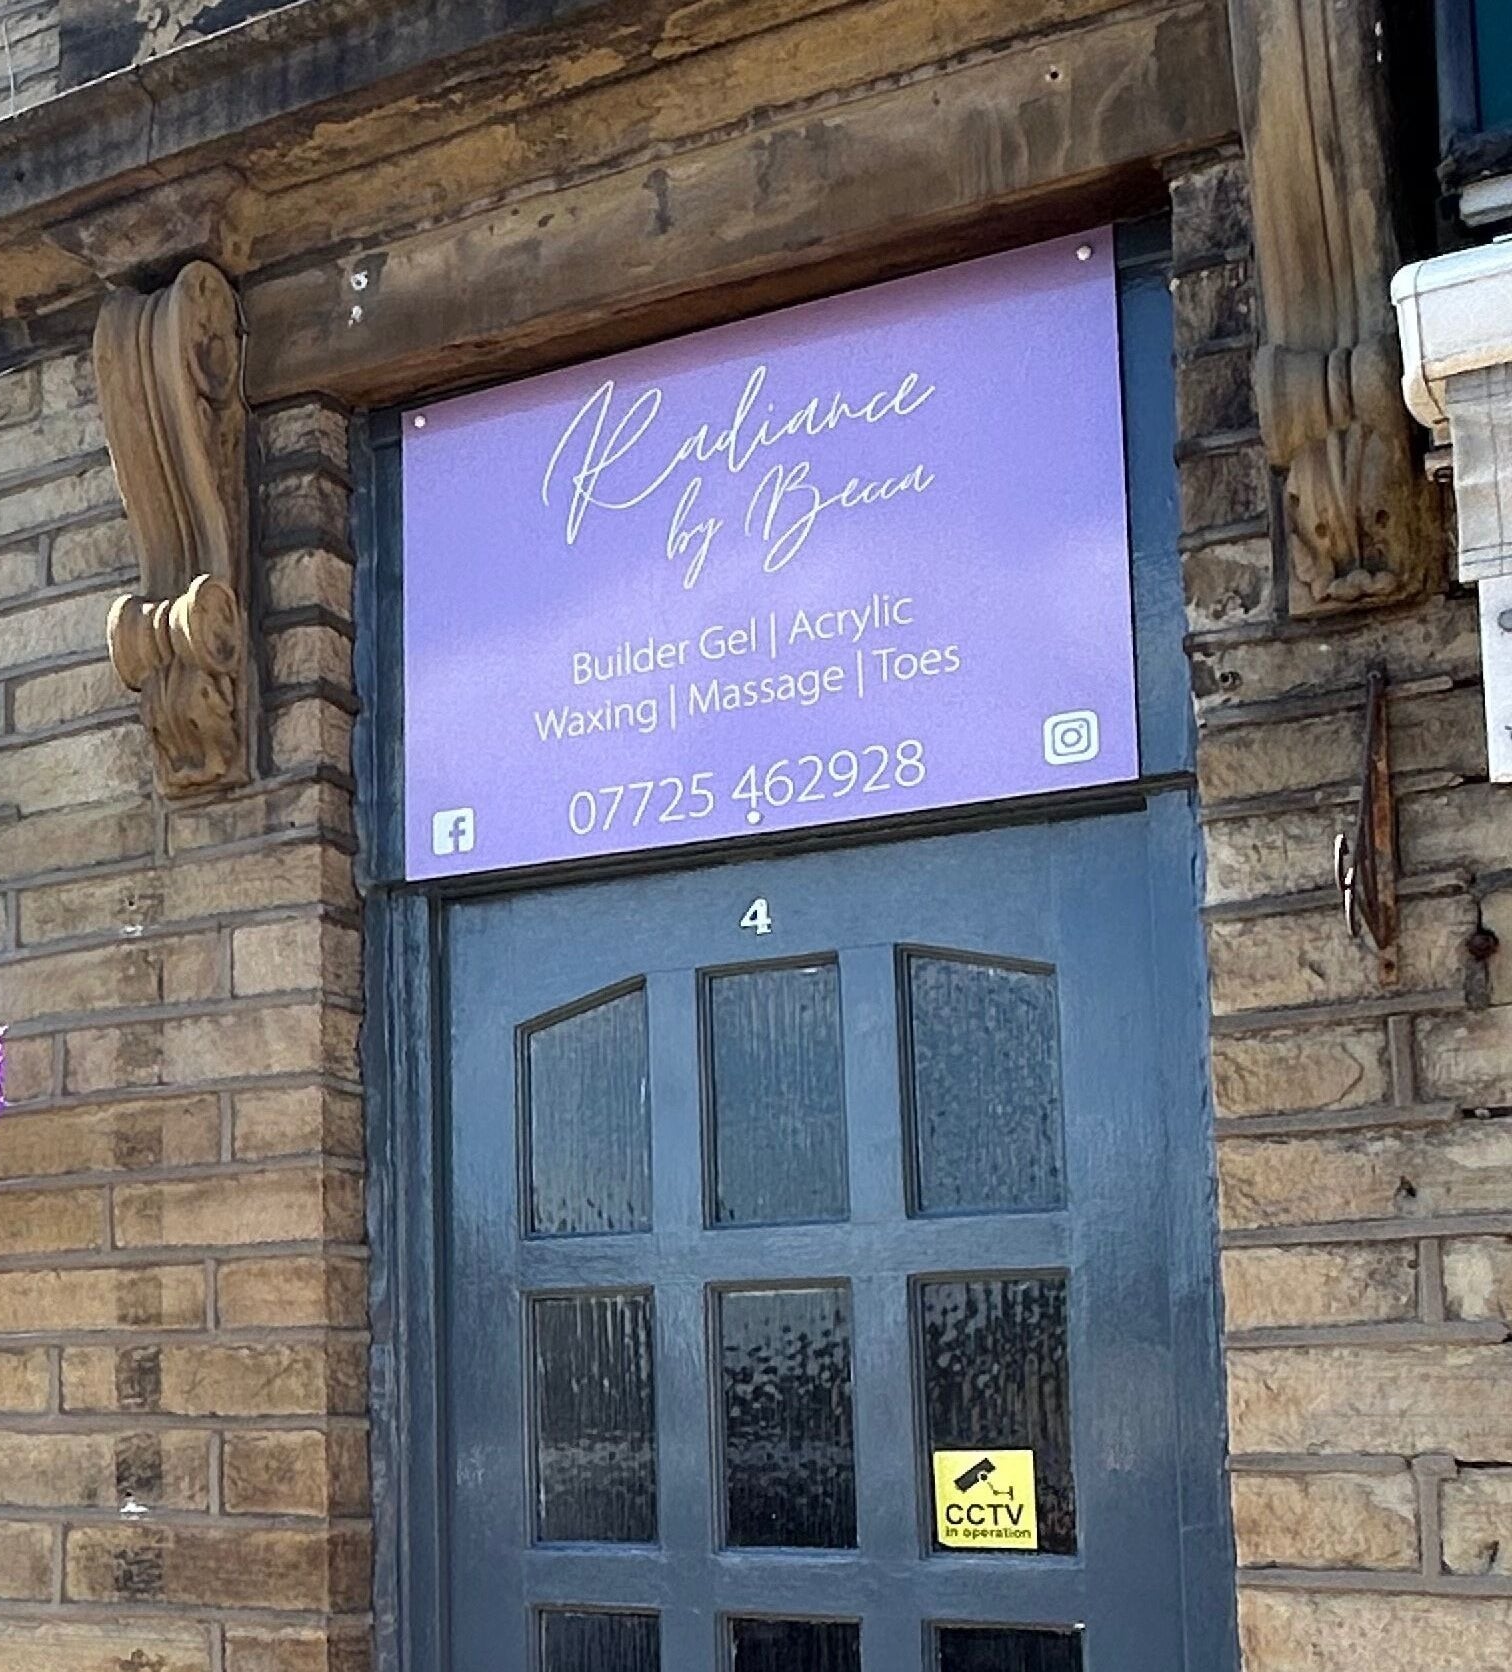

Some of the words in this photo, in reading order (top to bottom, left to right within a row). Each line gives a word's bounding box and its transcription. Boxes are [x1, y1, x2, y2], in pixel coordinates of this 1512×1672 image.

[542, 365, 936, 545] Radiance
[666, 477, 724, 589] by
[744, 461, 936, 573] Becca
[572, 635, 690, 686] Builder
[698, 616, 757, 660] Gel
[788, 592, 914, 644] Acrylic
[534, 698, 658, 742] Waxing
[688, 665, 845, 717] Massage
[871, 644, 961, 684] Toes
[568, 771, 715, 836] 07725
[731, 739, 926, 808] 462928
[739, 896, 773, 936] 4
[945, 1503, 1024, 1526] CCTV
[945, 1526, 958, 1537] in
[963, 1526, 1032, 1540] operation
